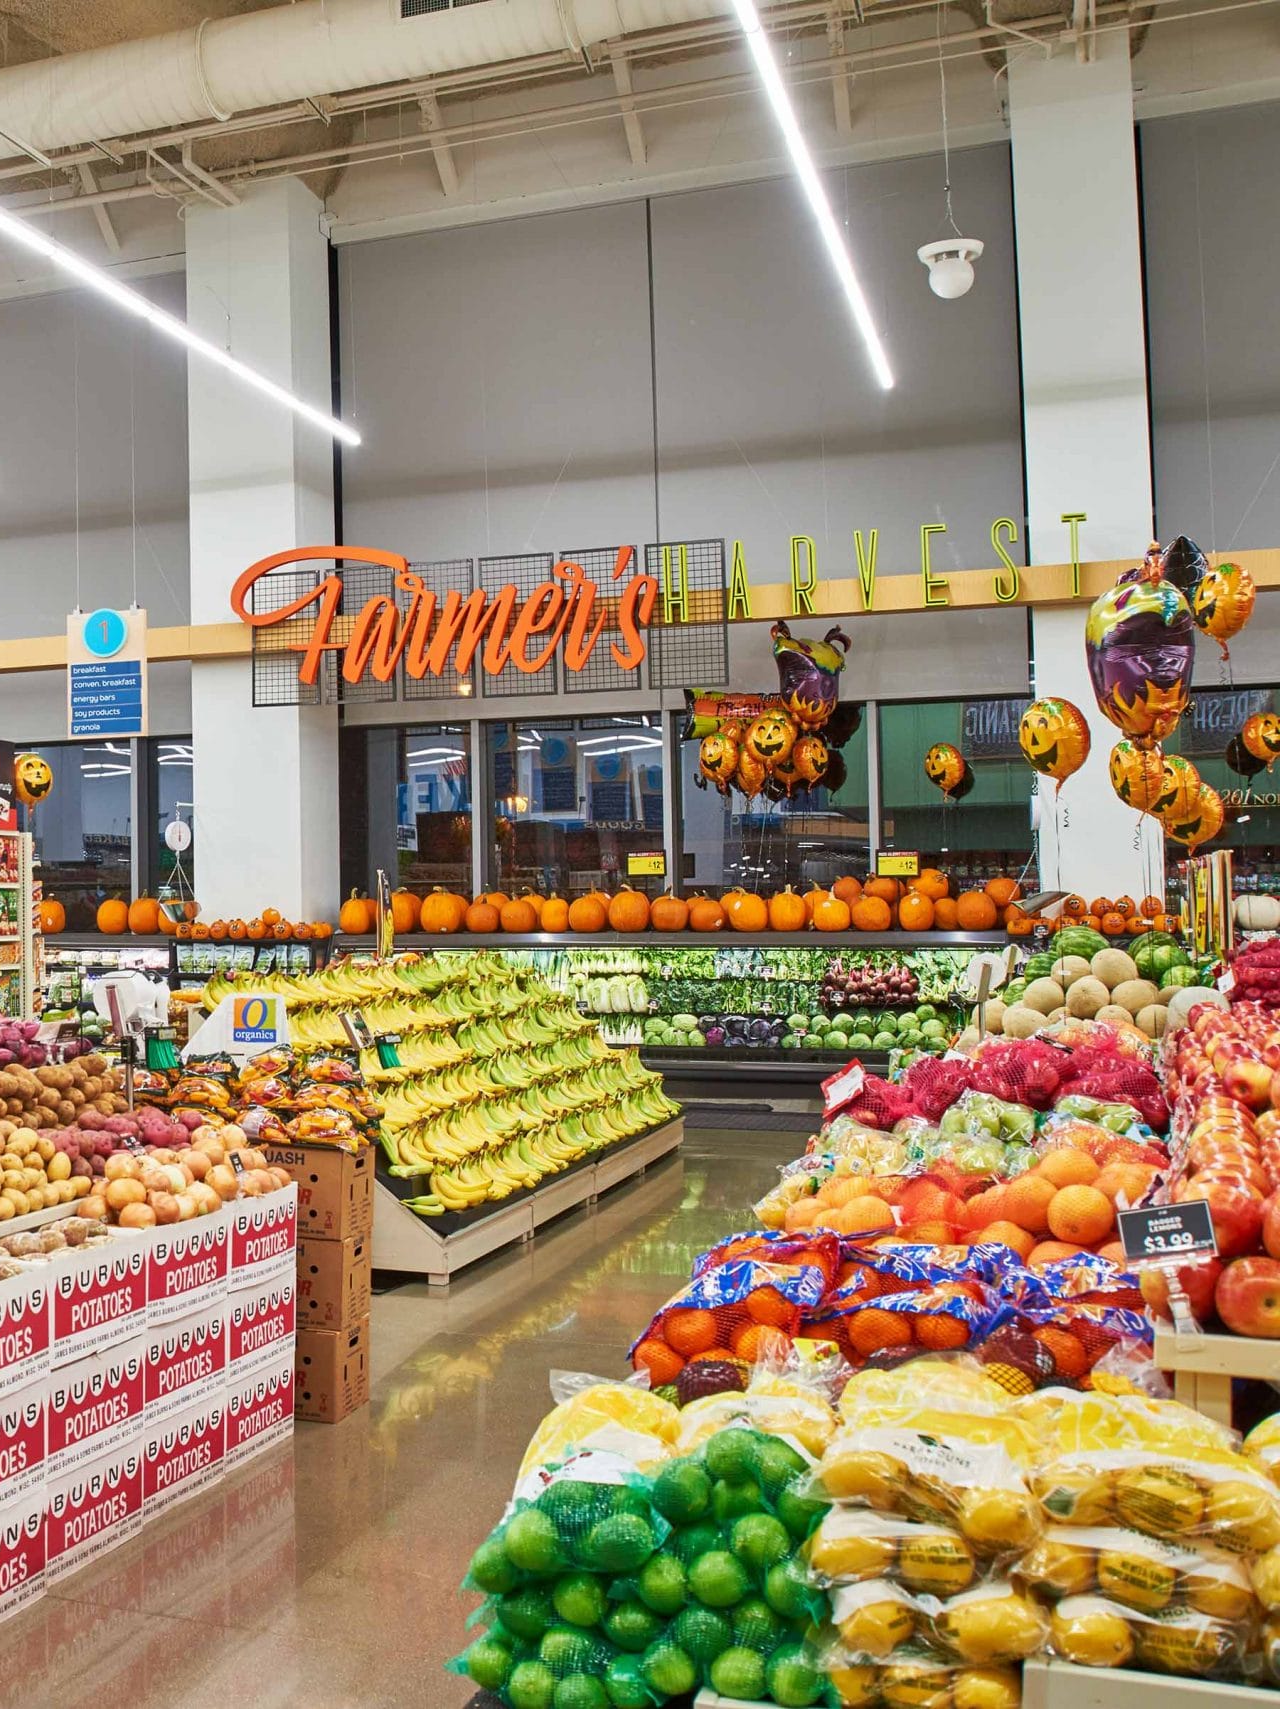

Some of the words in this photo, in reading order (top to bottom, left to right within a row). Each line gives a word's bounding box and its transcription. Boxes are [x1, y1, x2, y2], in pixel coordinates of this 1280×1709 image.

[662, 512, 1088, 623] HARVEST
[98, 620, 108, 644] 1
[231, 544, 654, 685] Farmer's
[73, 666, 106, 674] breakfast
[102, 678, 136, 687] breakfast
[73, 696, 98, 704] energy
[100, 694, 116, 702] bars
[88, 708, 120, 717] products
[73, 724, 100, 733] granola
[235, 1029, 274, 1041] organics
[238, 1201, 294, 1231] BURNS
[156, 1226, 225, 1260] BURNS
[245, 1228, 288, 1263] POTATOES
[1144, 1232, 1193, 1253] $3.99
[61, 1253, 140, 1294] BURNS
[166, 1256, 217, 1296] POTATOES
[71, 1286, 132, 1332] POTATOES
[233, 1286, 291, 1322] BURNS
[150, 1319, 220, 1362] BURNS
[241, 1314, 285, 1354] POTATOES
[54, 1358, 136, 1408] BURNS
[159, 1350, 212, 1395] POTATOES
[231, 1369, 289, 1411] BURNS
[65, 1392, 128, 1445] POTATOES
[148, 1410, 220, 1458] BURNS
[238, 1398, 283, 1442] POTATOES
[54, 1457, 136, 1512] BURNS
[156, 1441, 211, 1490] POTATOES
[64, 1492, 127, 1549] POTATOES
